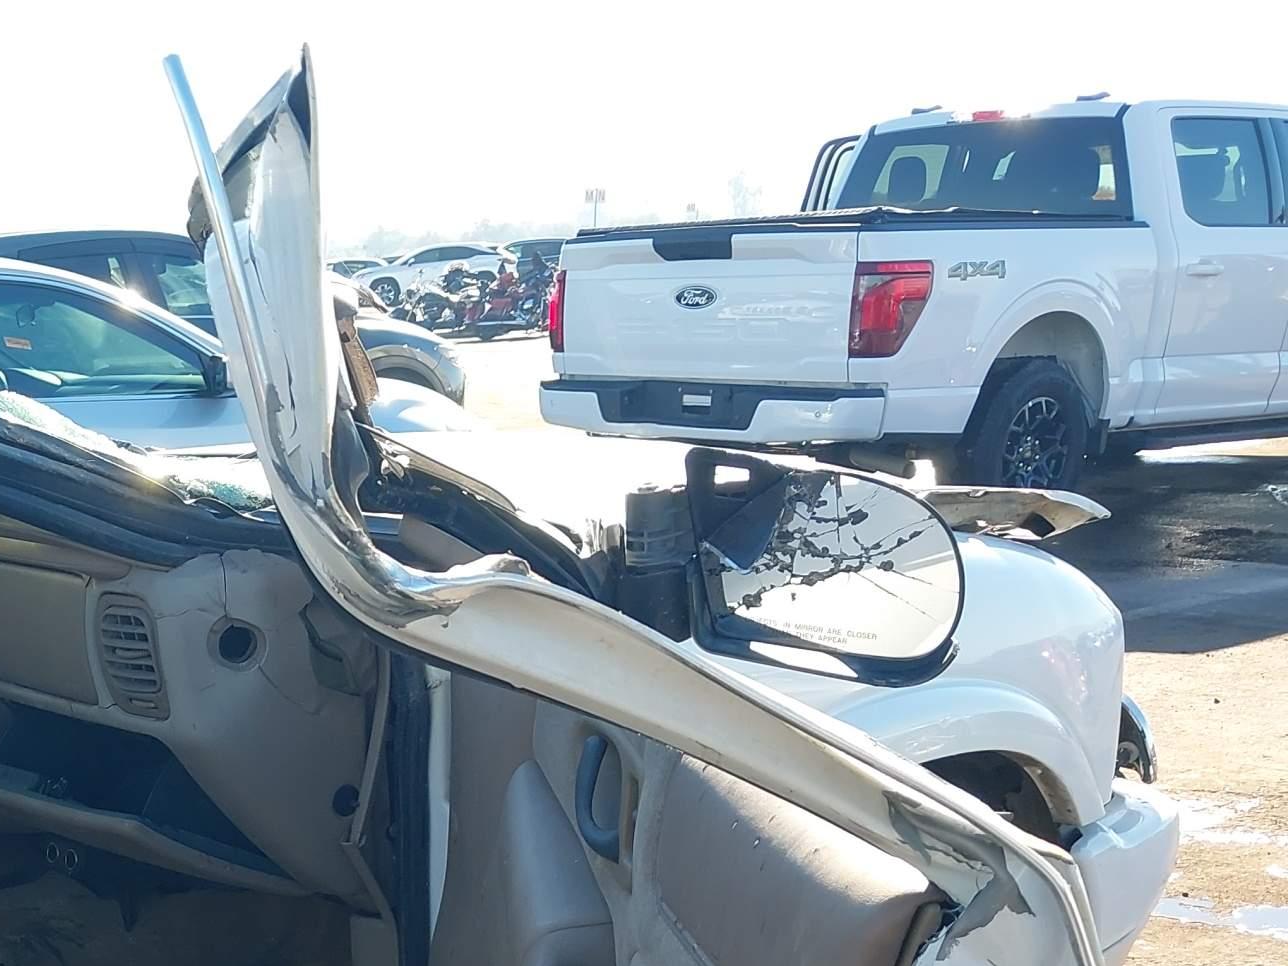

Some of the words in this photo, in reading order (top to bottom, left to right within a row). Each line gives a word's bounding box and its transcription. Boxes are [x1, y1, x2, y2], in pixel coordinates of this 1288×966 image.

[678, 288, 713, 305] Ford
[795, 624, 823, 633] MIRROR
[847, 630, 878, 640] CLOSER
[818, 635, 848, 644] APPEAR
